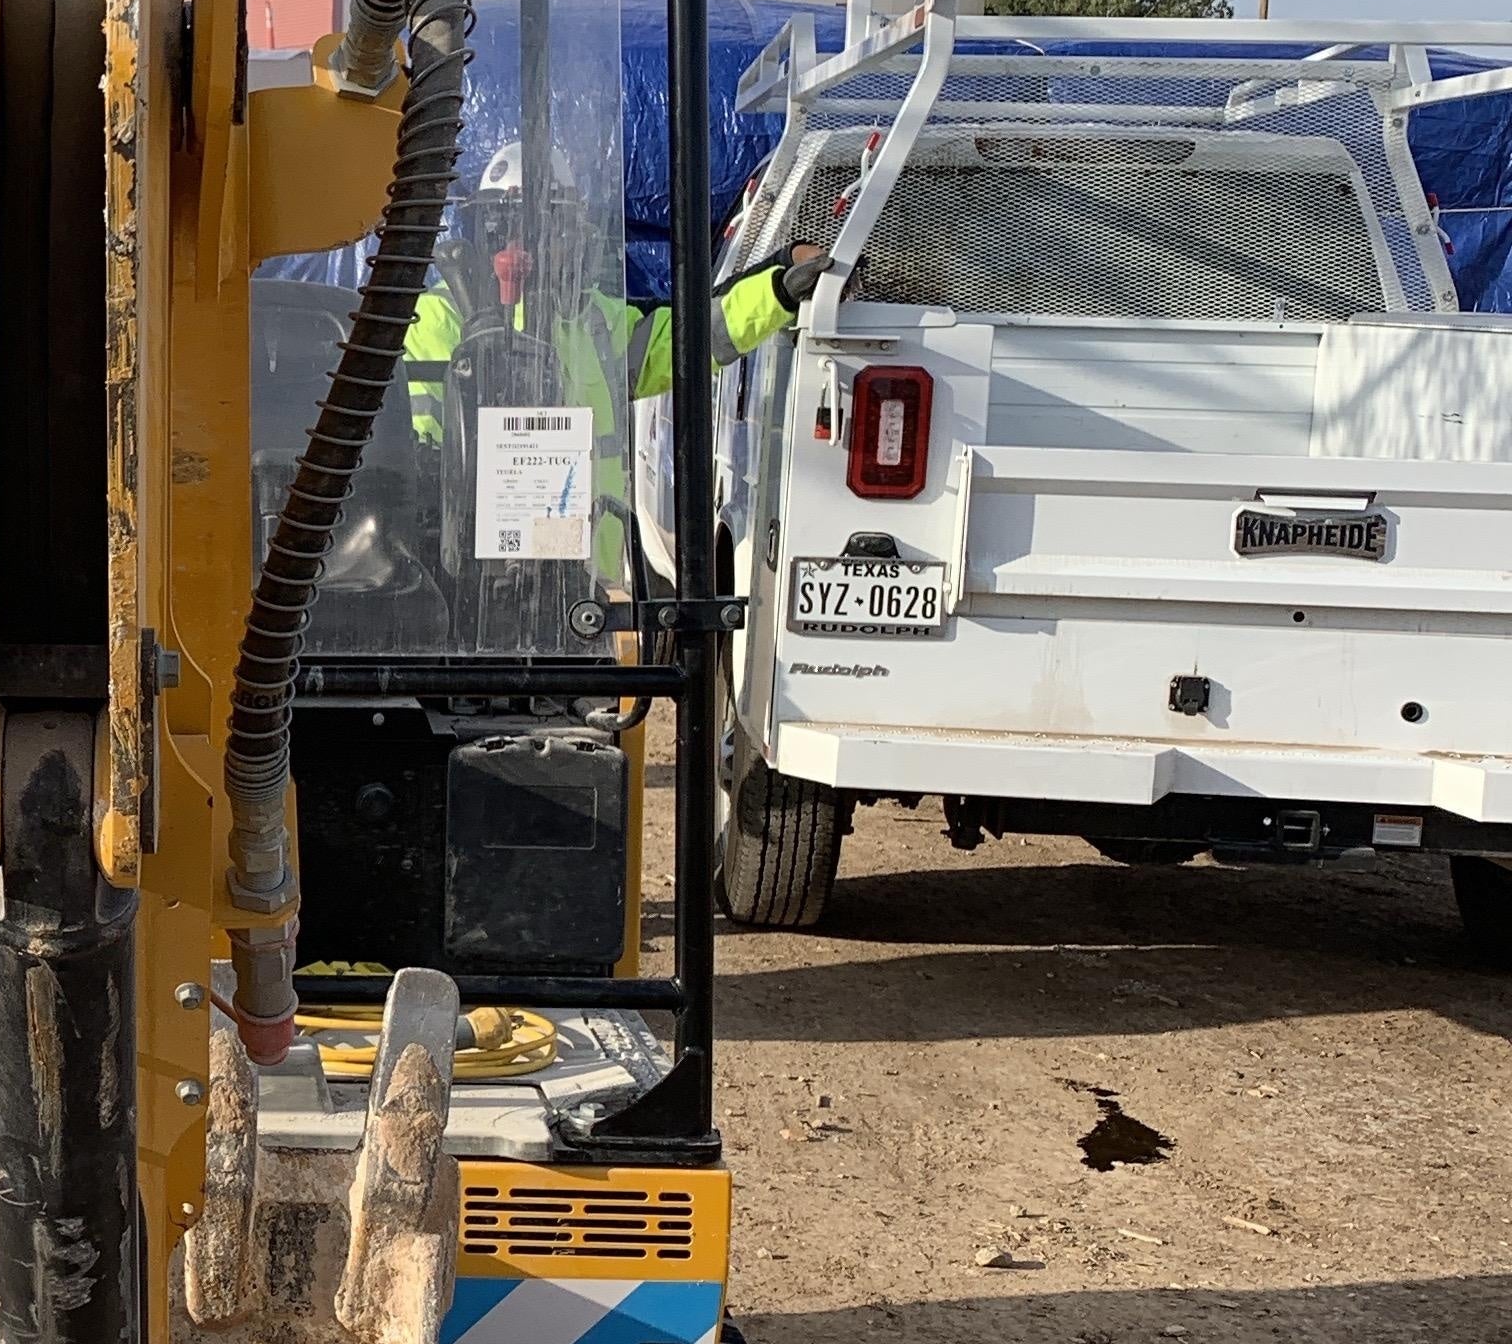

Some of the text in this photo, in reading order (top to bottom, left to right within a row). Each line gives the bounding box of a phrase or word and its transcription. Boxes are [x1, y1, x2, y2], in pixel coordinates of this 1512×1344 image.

[1241, 516, 1380, 553] KNAPHEIDE
[841, 563, 900, 578] TEXAS
[869, 584, 937, 619] 0628
[802, 622, 931, 636] RUDOLPH
[788, 662, 890, 678] Rudolph
